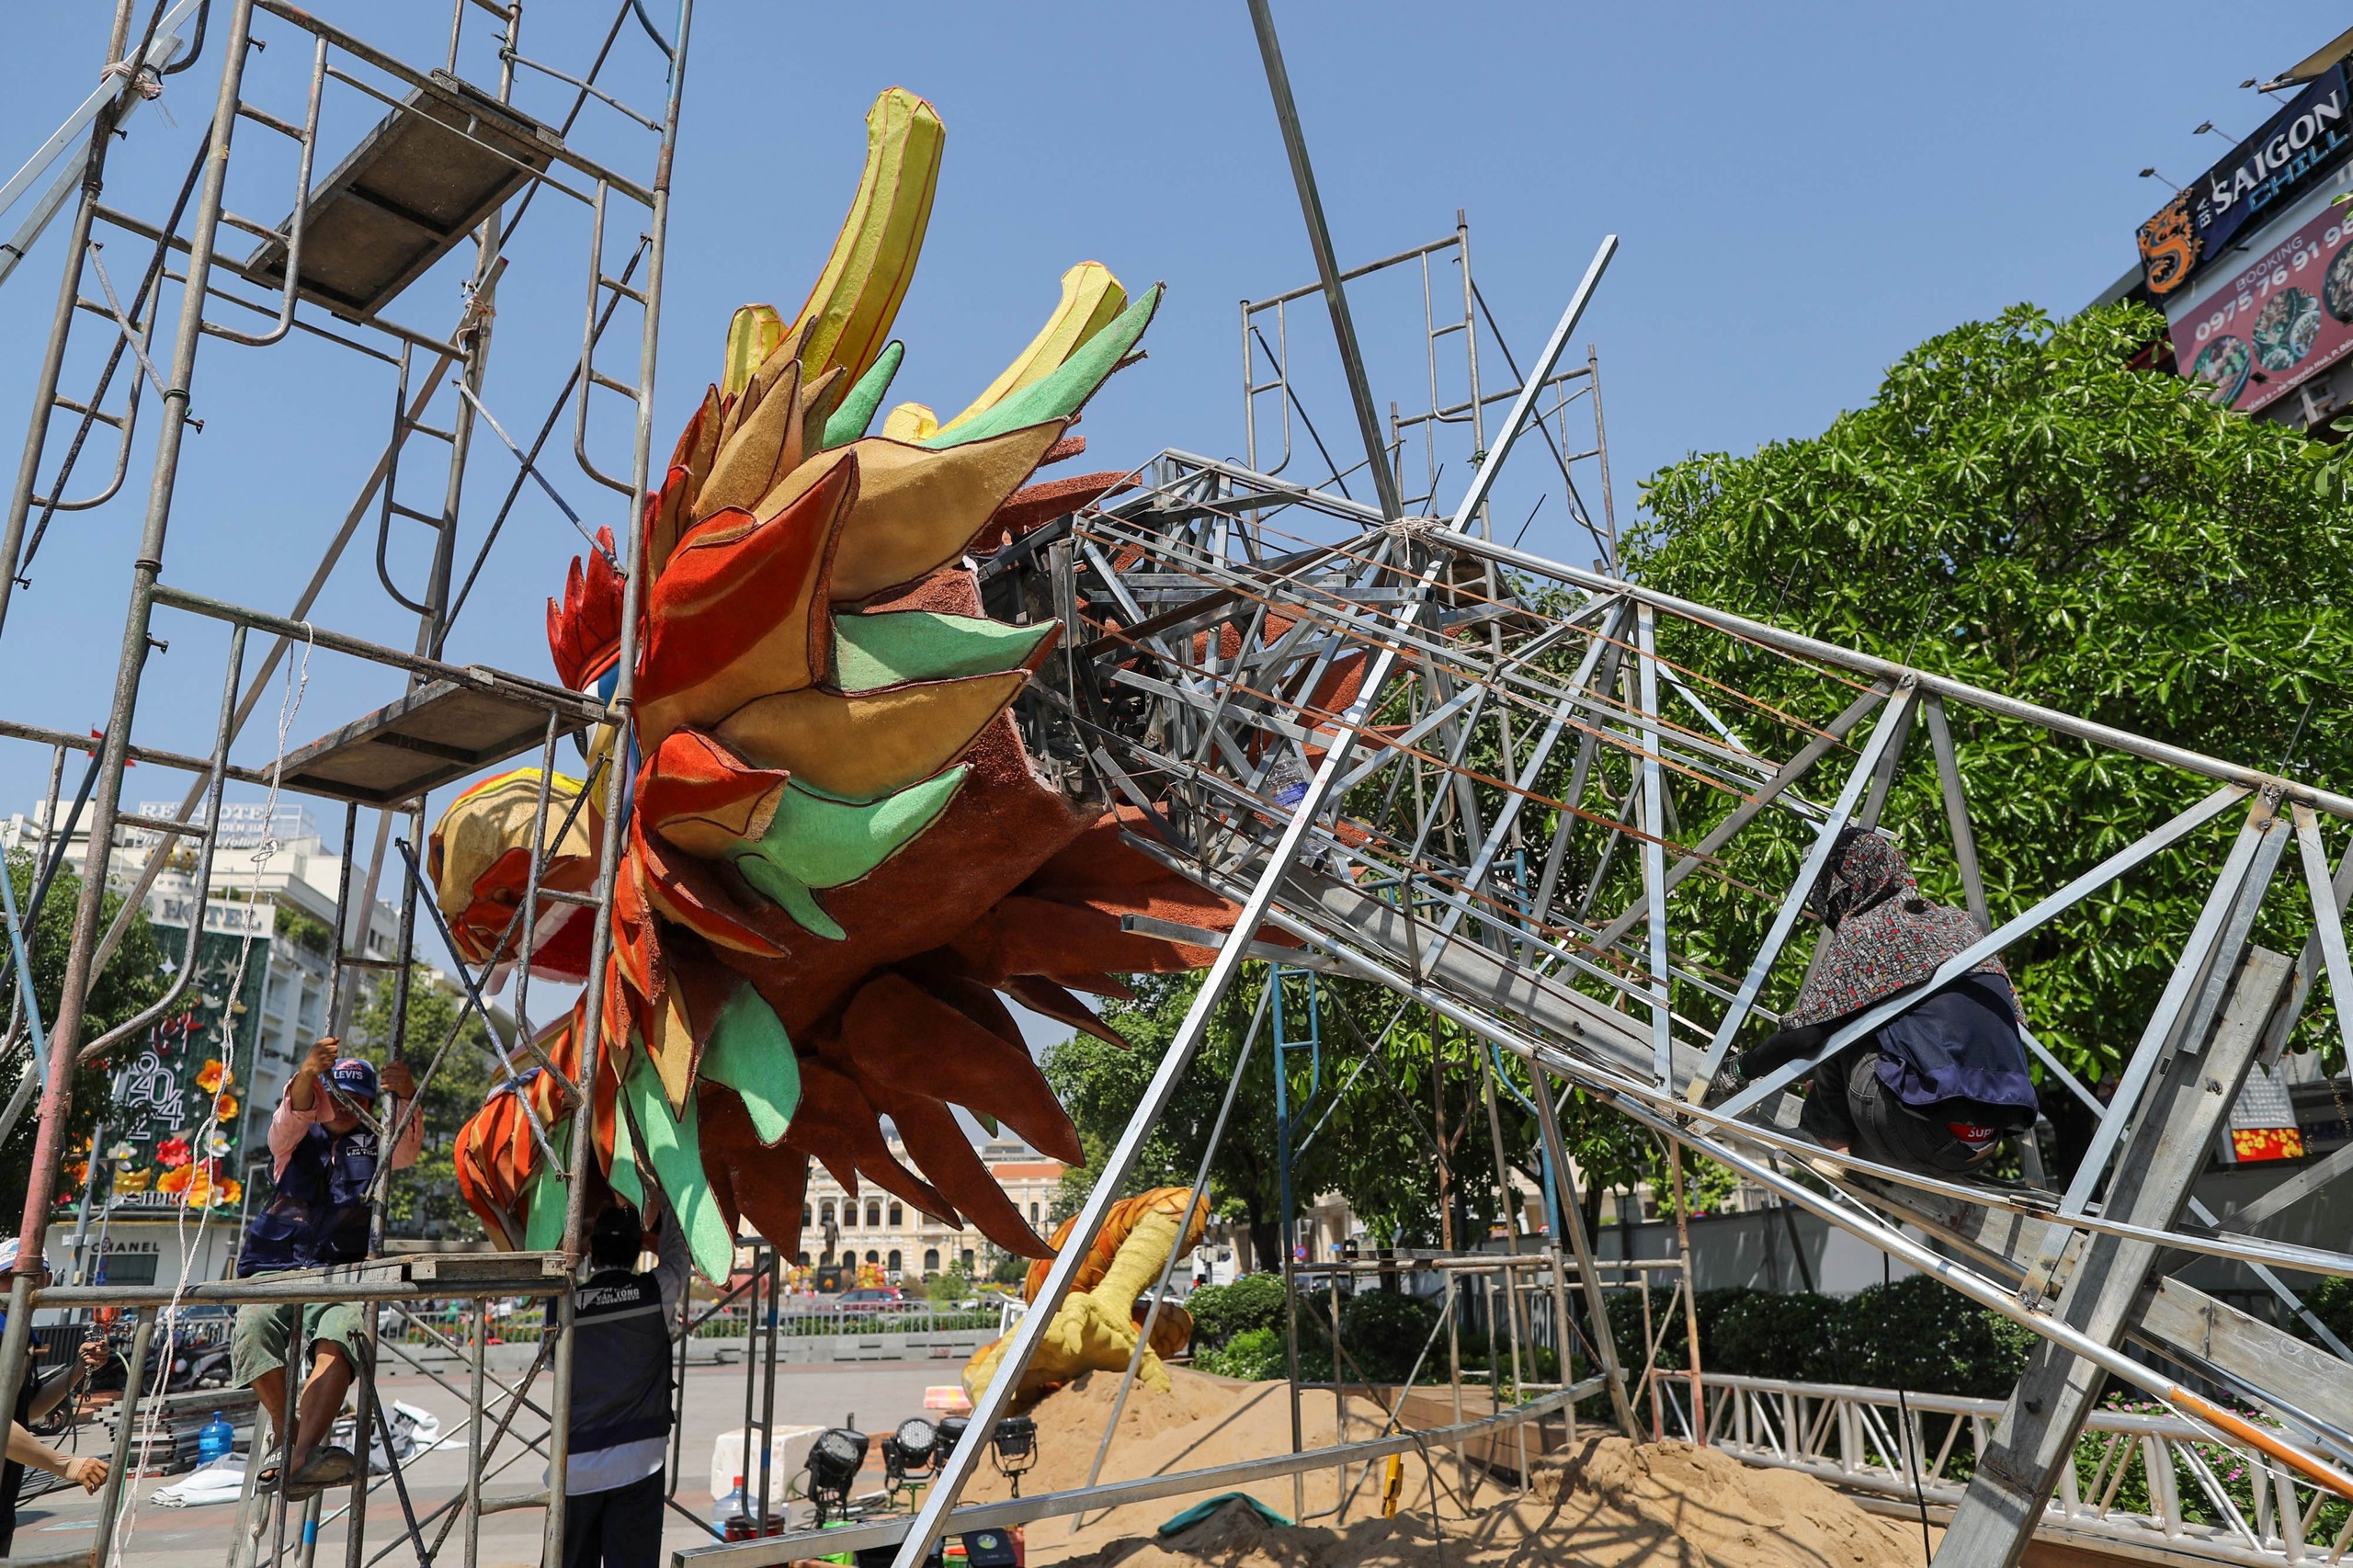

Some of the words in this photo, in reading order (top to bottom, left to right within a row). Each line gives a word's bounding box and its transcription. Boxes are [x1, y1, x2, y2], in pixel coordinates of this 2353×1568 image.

[2211, 89, 2343, 215] SAIGON
[2248, 131, 2349, 213] CHILL
[2197, 198, 2211, 229] BIA
[2195, 290, 2253, 341] 0975
[2256, 265, 2289, 298] 76
[2291, 241, 2320, 272] 91
[2235, 235, 2303, 292] BOOKING
[334, 1070, 363, 1080] LEVI'S
